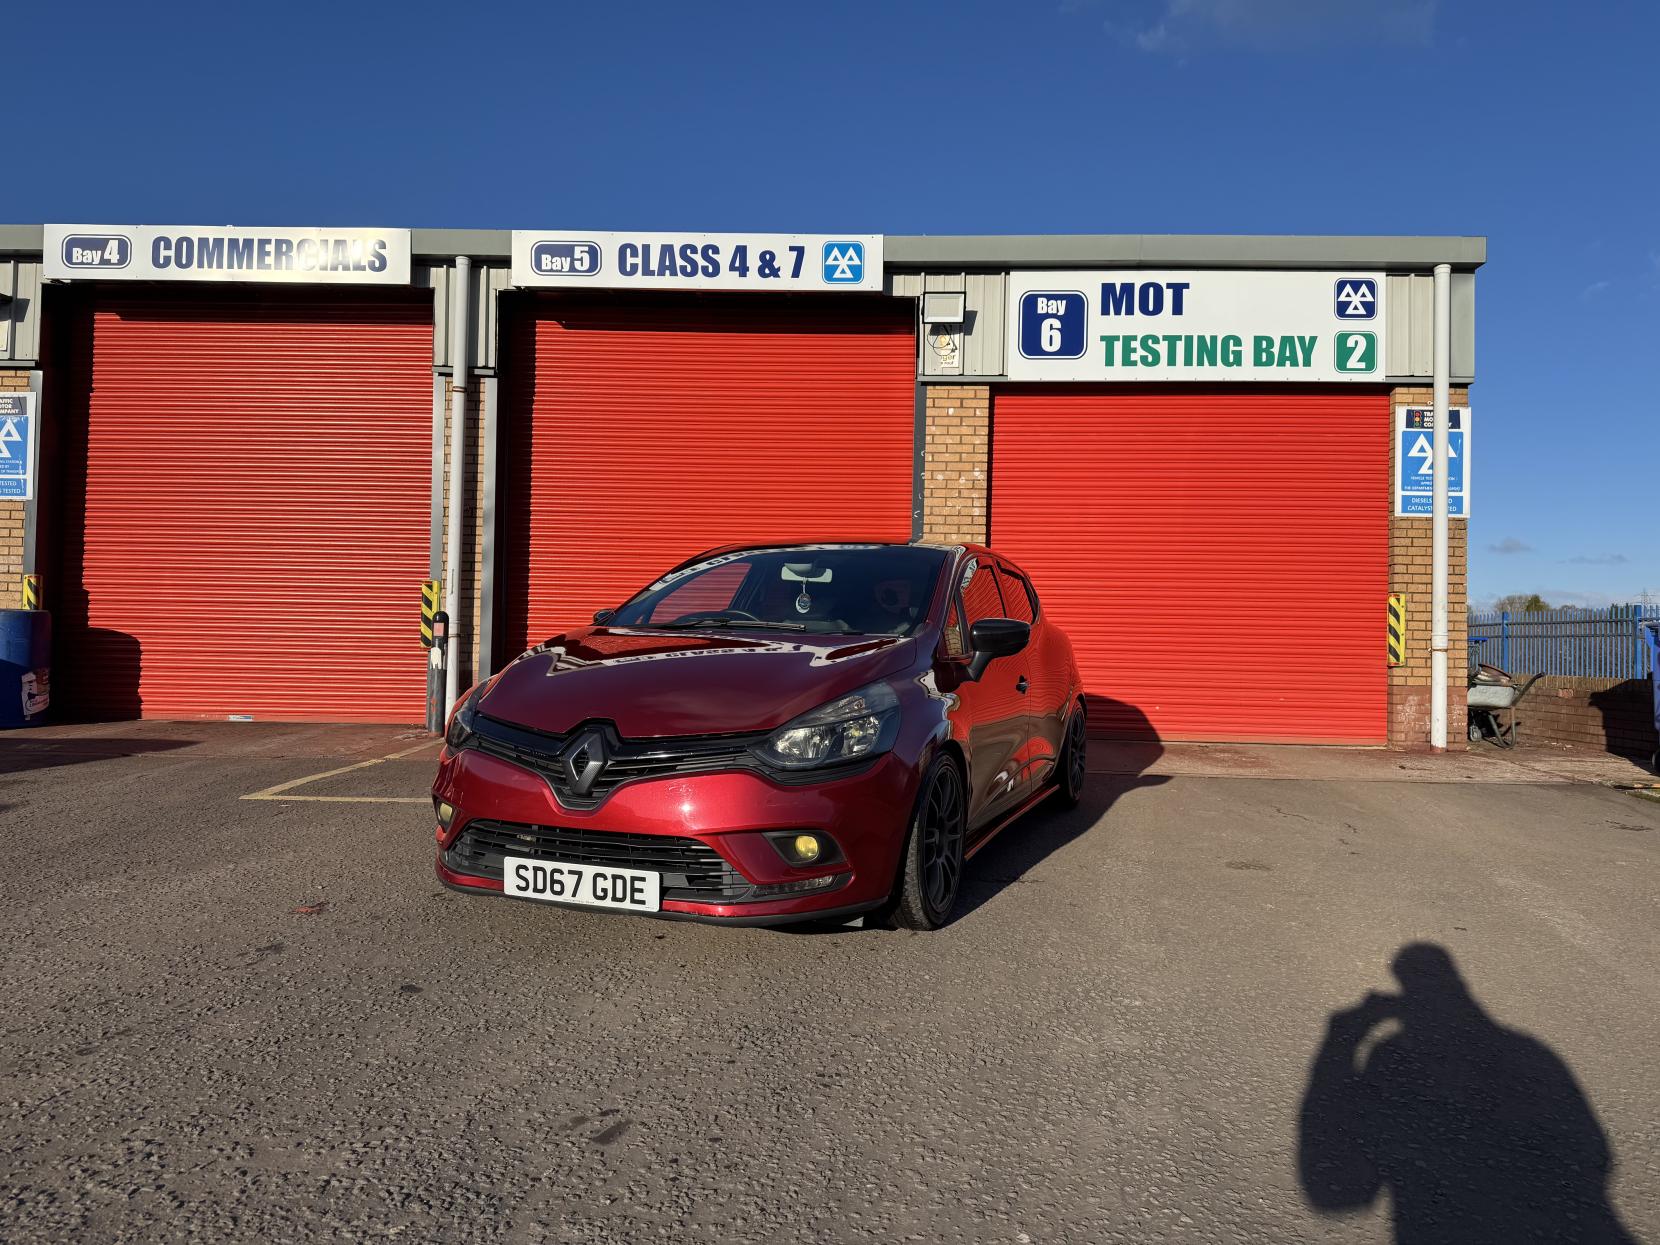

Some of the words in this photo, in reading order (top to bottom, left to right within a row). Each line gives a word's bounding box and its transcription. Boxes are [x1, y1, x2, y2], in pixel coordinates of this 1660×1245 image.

[72, 247, 102, 265] Bay
[103, 239, 120, 264] 4
[151, 235, 388, 273] COMMERCIALS
[541, 254, 570, 272] Bay
[573, 246, 591, 271] 5
[618, 243, 721, 277] CLASS
[728, 244, 750, 278] 4
[757, 250, 781, 279] &
[788, 245, 806, 279] 7
[1037, 297, 1067, 316] Bay
[1100, 282, 1190, 316] MOT
[1040, 318, 1062, 352] 6
[1099, 334, 1243, 367] TESTING
[1252, 335, 1318, 367] BAY
[1346, 334, 1367, 369] 2
[515, 864, 583, 898] SD67
[592, 872, 647, 906] GDE
